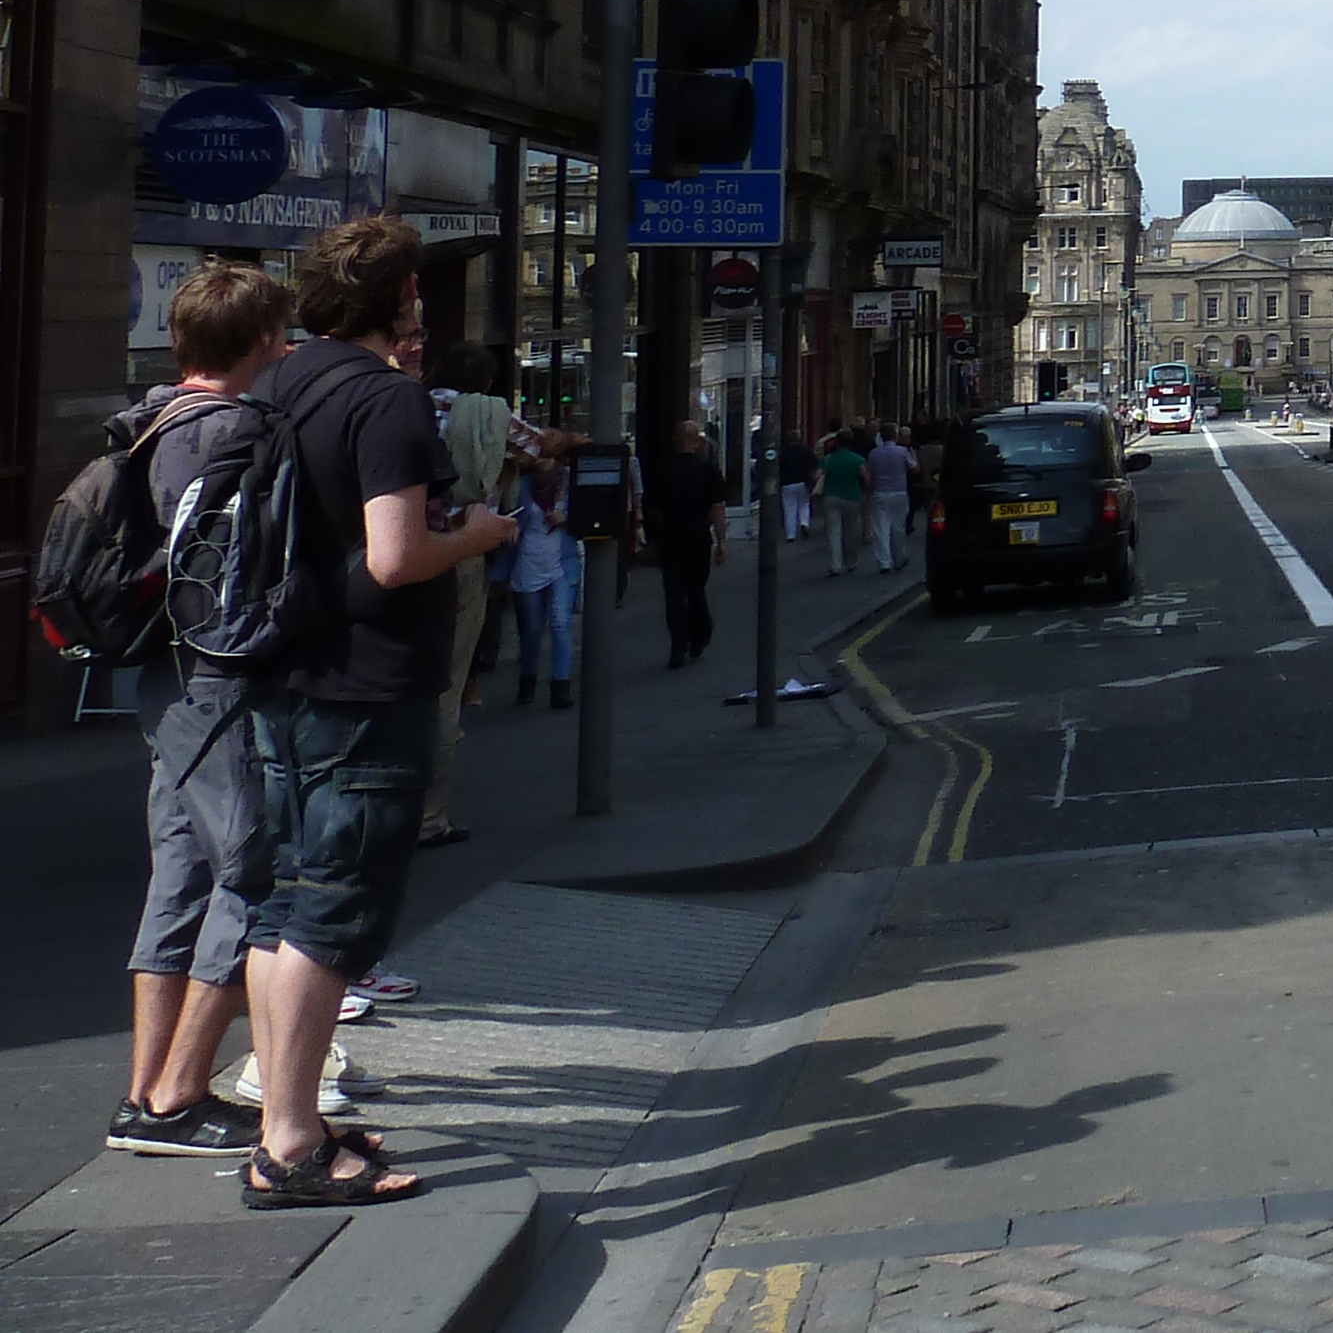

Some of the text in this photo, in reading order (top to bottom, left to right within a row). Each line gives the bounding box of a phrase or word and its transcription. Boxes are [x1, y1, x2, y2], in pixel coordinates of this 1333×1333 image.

[200, 133, 239, 146] THE
[164, 150, 273, 163] SCOTSMAN
[237, 193, 344, 229] NEWSAGENTS
[429, 216, 469, 230] ROYAL
[638, 218, 765, 237] 4.00-6.30pm
[887, 247, 941, 259] ARCADE
[856, 311, 887, 319] FLIGHT
